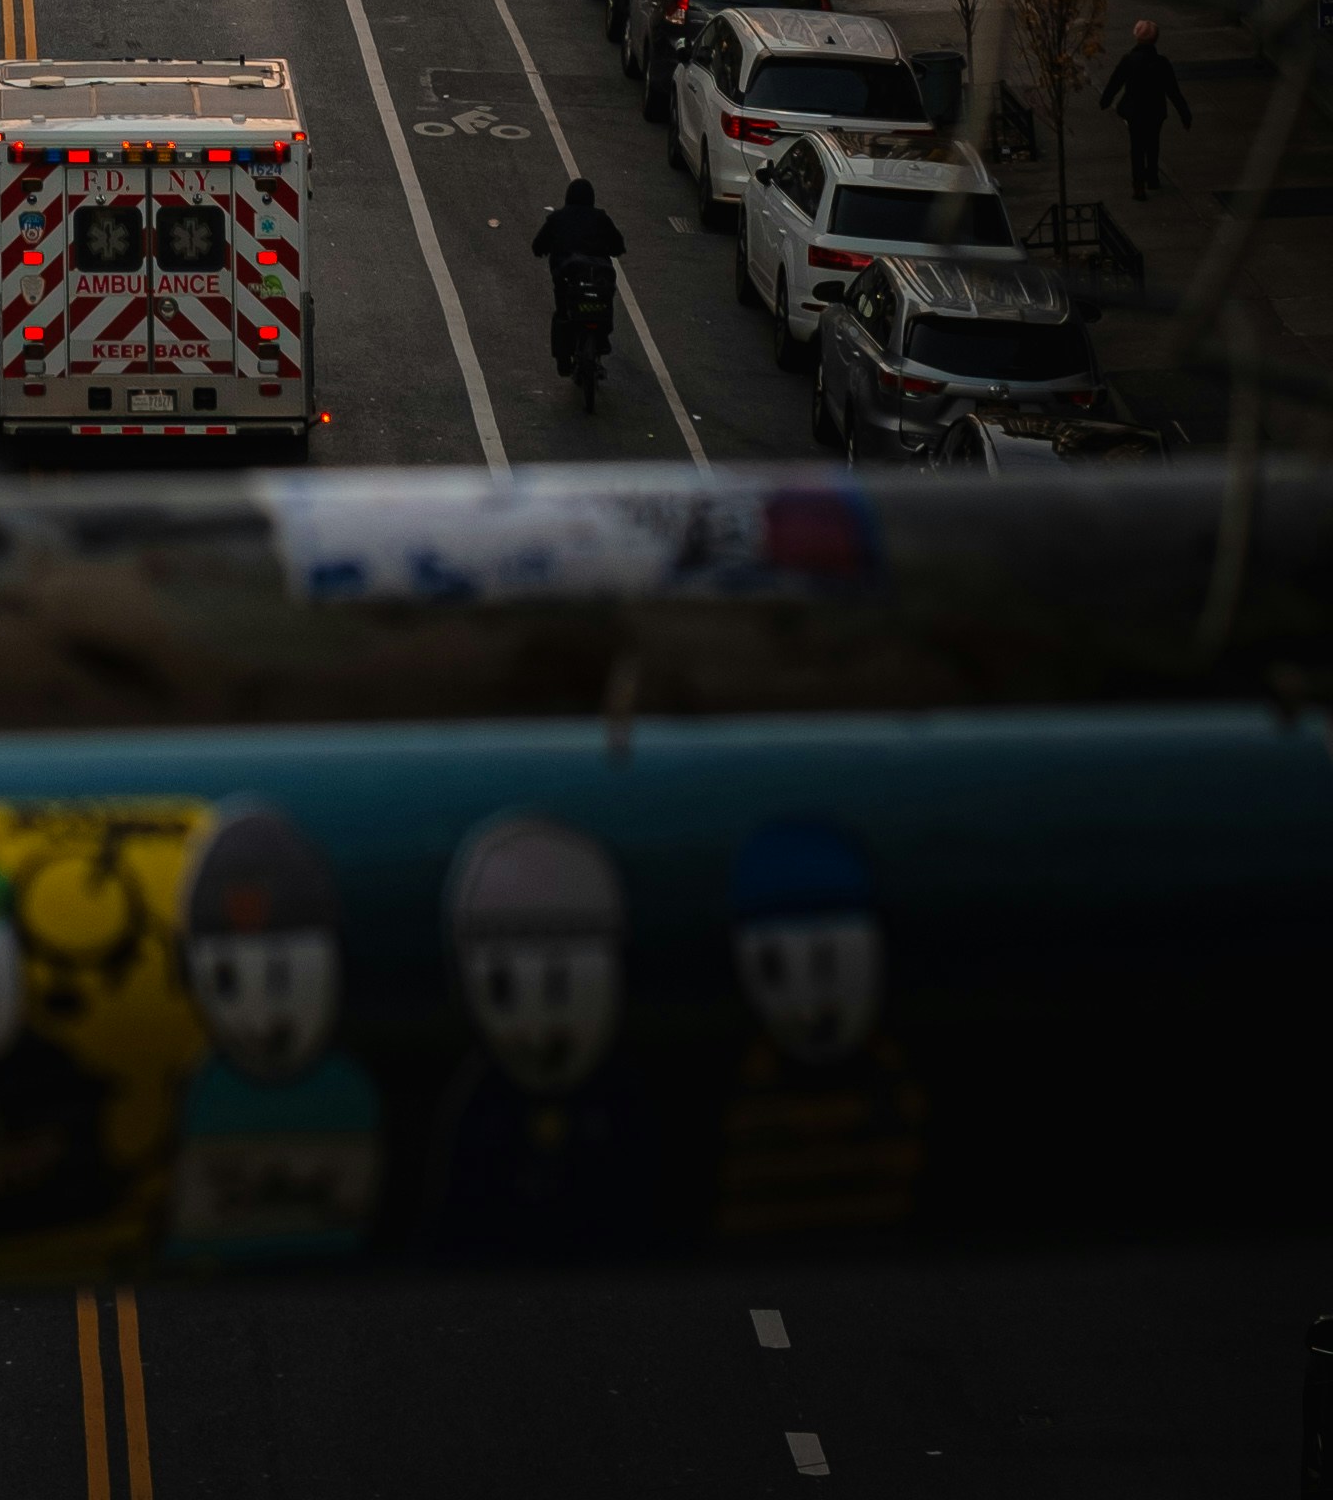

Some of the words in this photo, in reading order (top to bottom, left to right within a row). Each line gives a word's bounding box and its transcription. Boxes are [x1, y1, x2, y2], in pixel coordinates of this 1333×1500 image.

[247, 162, 283, 176] 1624
[83, 170, 130, 191] F.D.
[168, 170, 215, 191] N.Y.
[76, 275, 221, 295] AMBULANCE
[92, 344, 146, 359] KEEP
[155, 344, 211, 358] BACK
